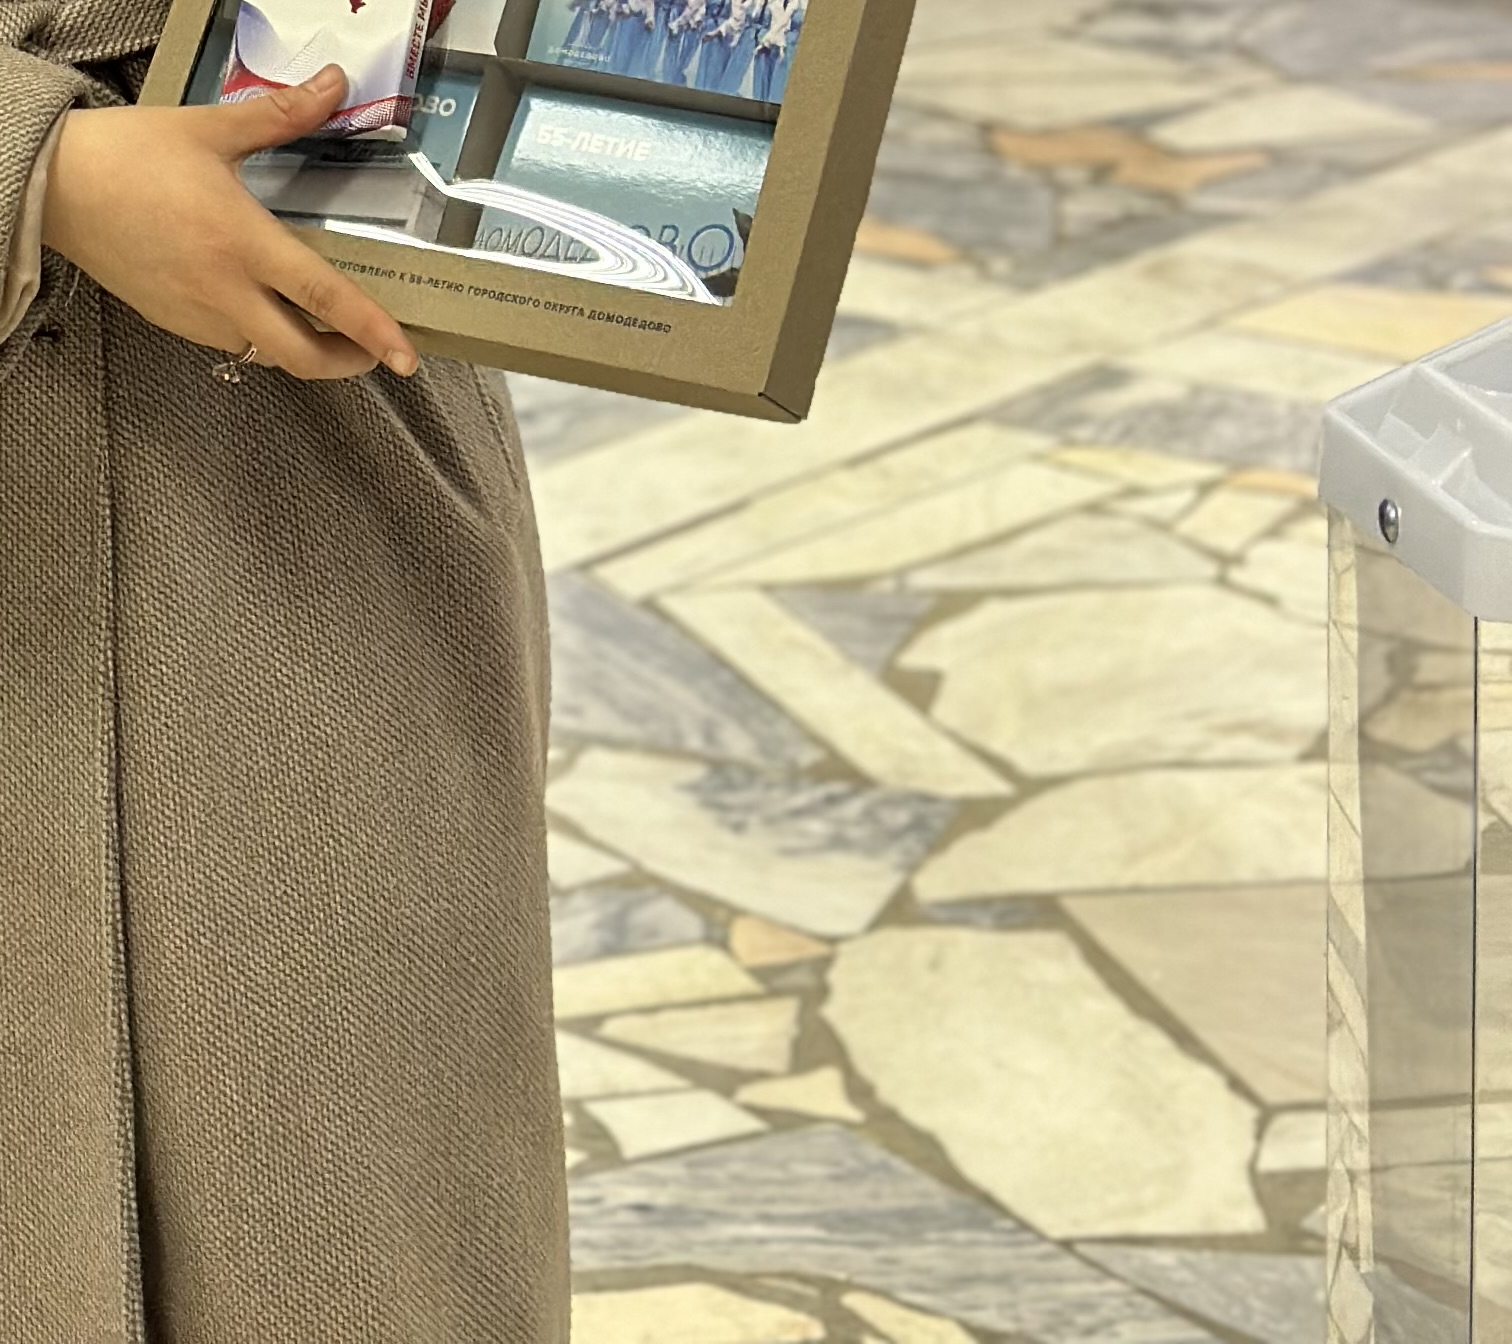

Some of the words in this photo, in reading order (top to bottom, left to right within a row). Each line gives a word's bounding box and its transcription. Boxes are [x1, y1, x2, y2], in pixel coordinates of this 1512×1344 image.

[467, 284, 541, 308] ГОРОДСКОГО
[543, 300, 585, 318] ОКРУГА
[587, 309, 673, 334] ДОМОДЕДОВО
